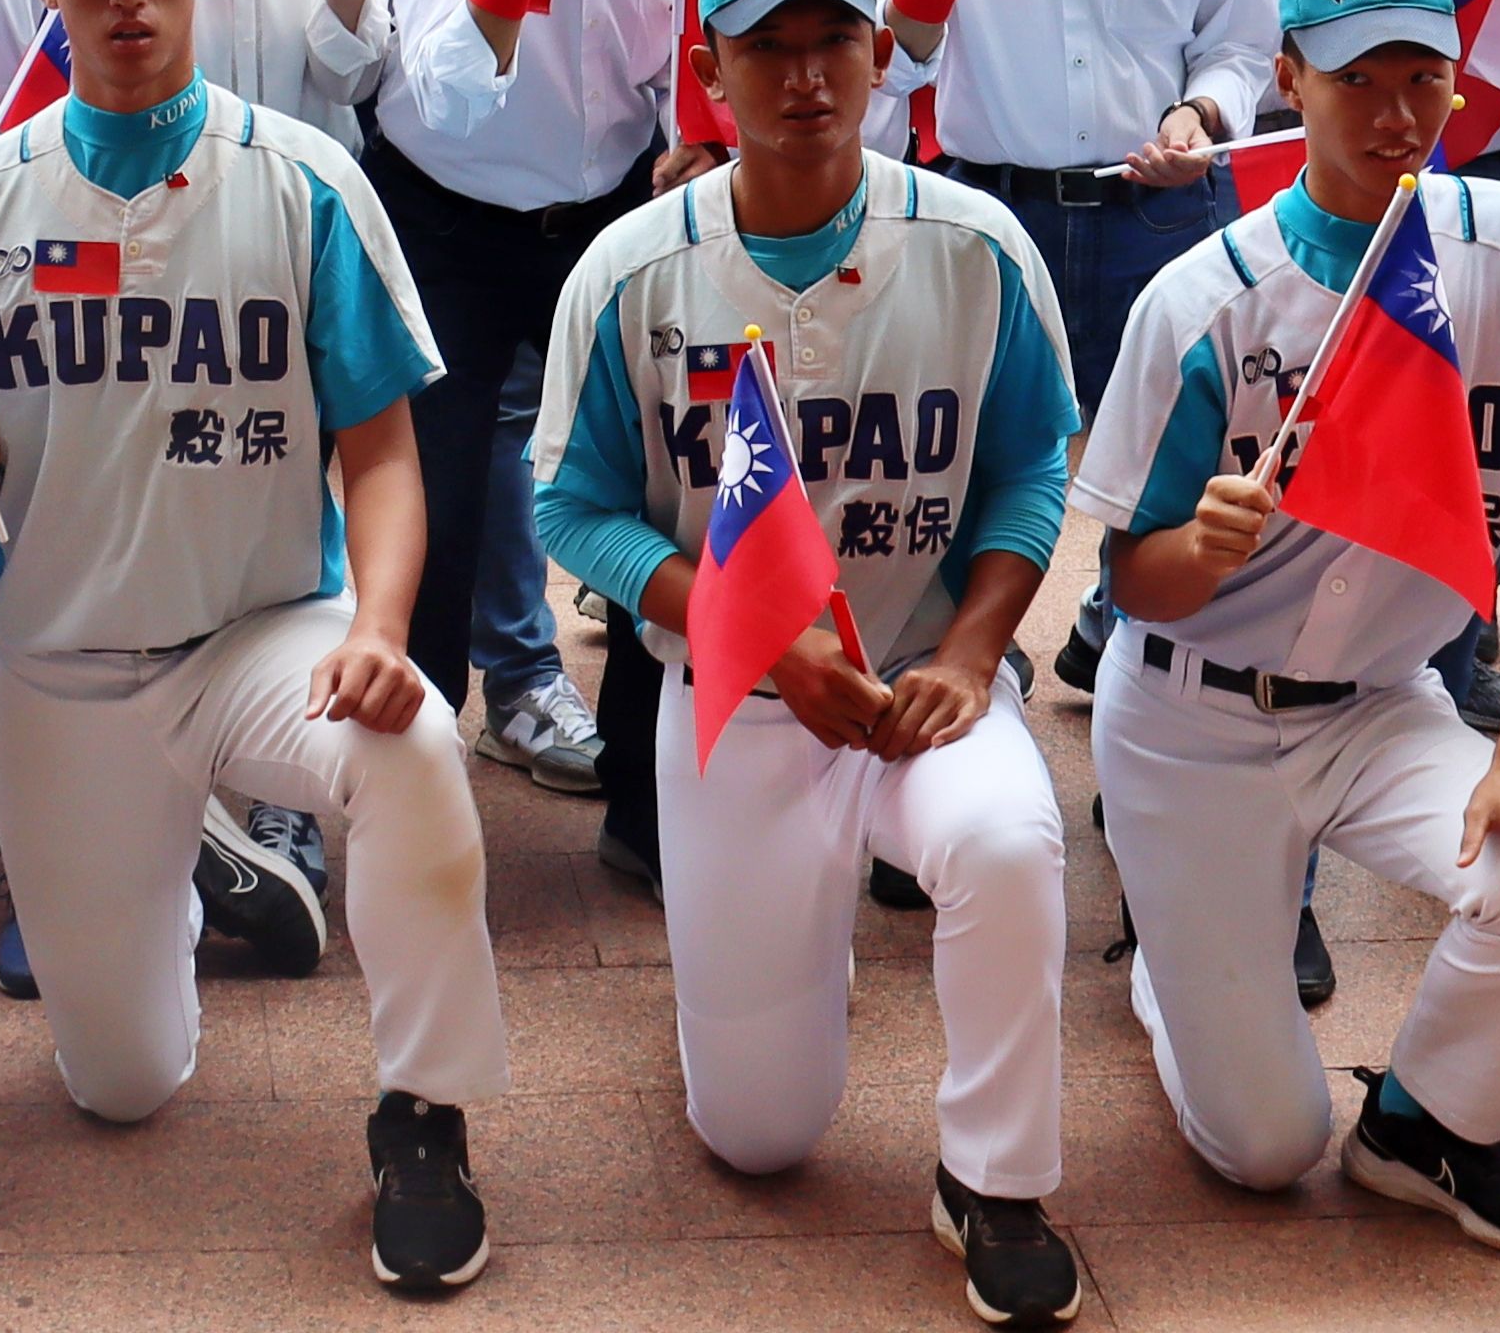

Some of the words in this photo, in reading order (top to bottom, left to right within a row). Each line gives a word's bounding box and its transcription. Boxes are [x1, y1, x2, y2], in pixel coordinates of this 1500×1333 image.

[164, 407, 289, 467] 穀保
[658, 387, 960, 490] KPAO
[837, 495, 952, 559] 穀保
